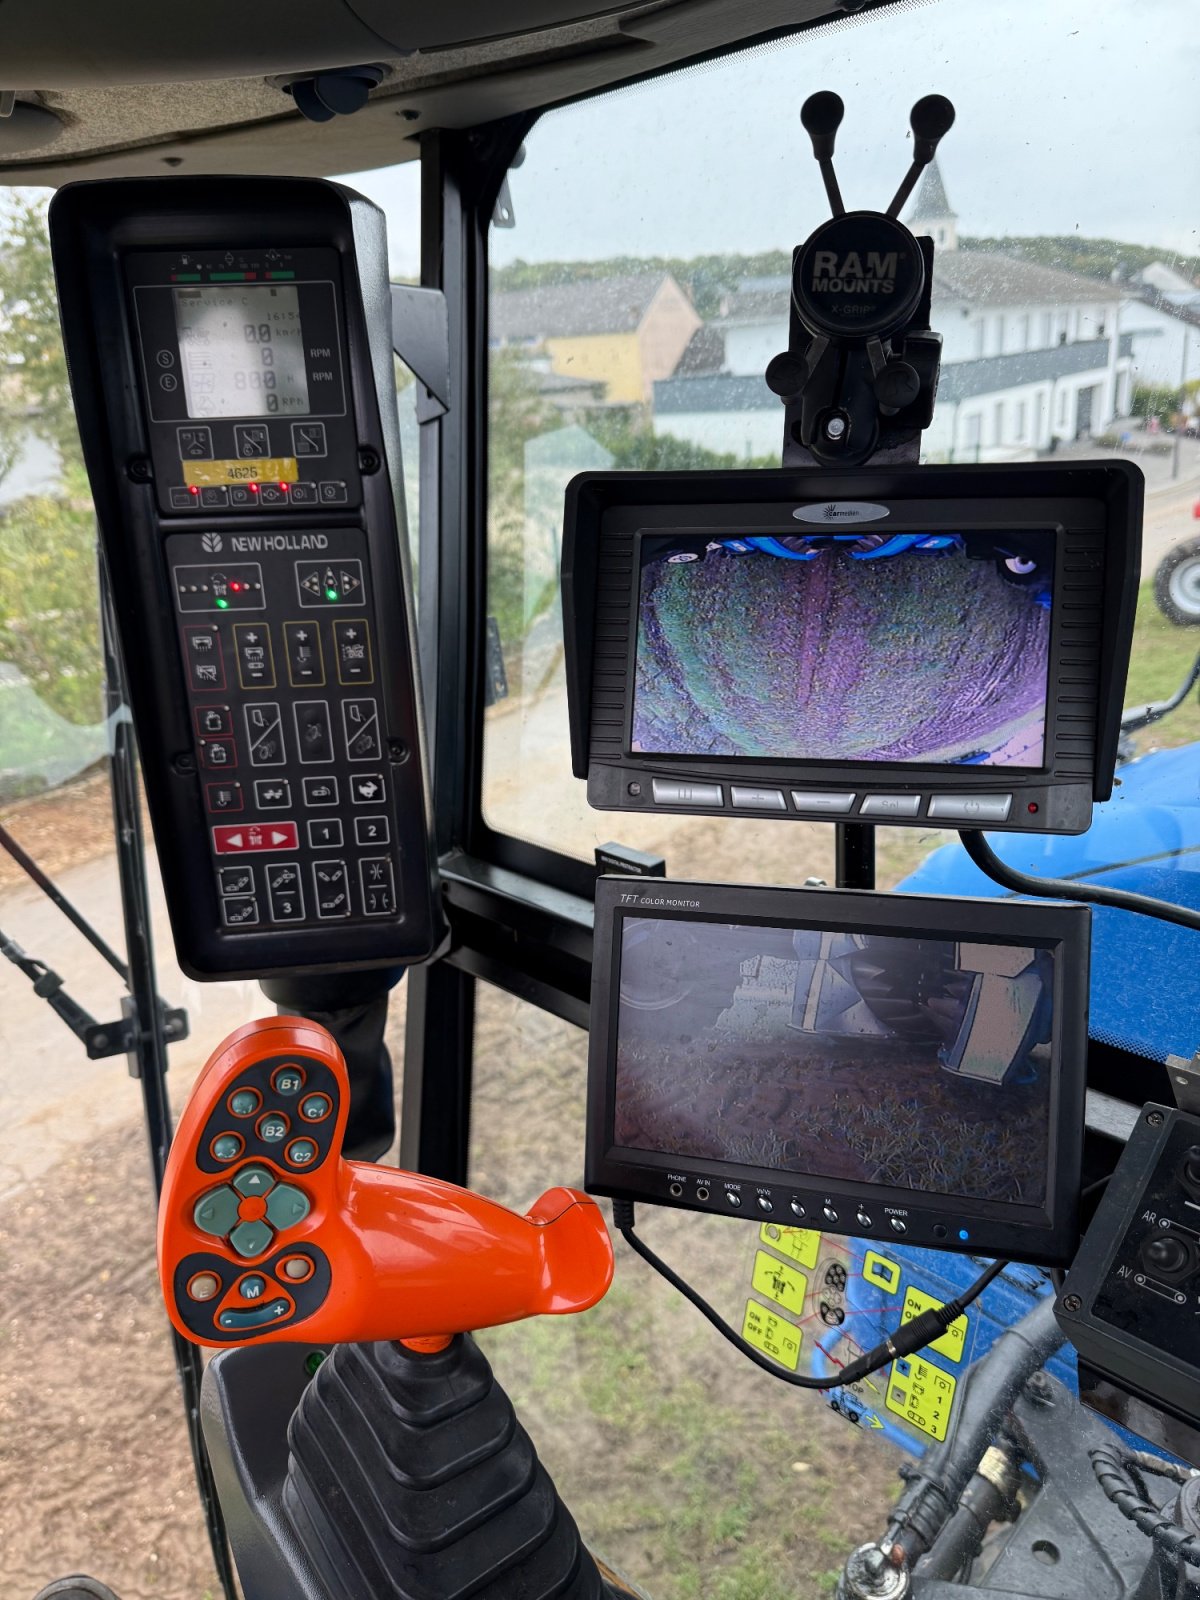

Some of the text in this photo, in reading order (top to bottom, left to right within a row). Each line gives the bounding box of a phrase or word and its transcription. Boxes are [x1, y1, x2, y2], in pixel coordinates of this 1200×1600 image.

[813, 251, 898, 279] RAM
[811, 278, 895, 294] MOUNTS
[310, 348, 331, 358] RPM
[312, 372, 333, 381] RPM
[226, 467, 259, 480] 4625
[231, 535, 329, 552] NEW HOLLAND
[322, 825, 377, 840] 1 2
[620, 893, 700, 908] TFT COLOR MONITOR
[283, 902, 292, 913] 3
[281, 1079, 300, 1091] B1
[307, 1107, 324, 1118] C1
[265, 1126, 284, 1138] B2
[294, 1152, 311, 1162] C2
[667, 1173, 687, 1183] PHONE
[724, 1182, 741, 1191] MODE
[884, 1207, 908, 1217] POWER
[1142, 1210, 1157, 1225] AR
[1116, 1265, 1133, 1280] AV
[246, 1285, 260, 1299] M
[907, 1298, 922, 1312] ON
[749, 1311, 762, 1324] ON
[747, 1322, 763, 1337] OFF
[937, 1395, 942, 1405] 1
[933, 1411, 940, 1421] 2
[930, 1425, 937, 1434] 3
